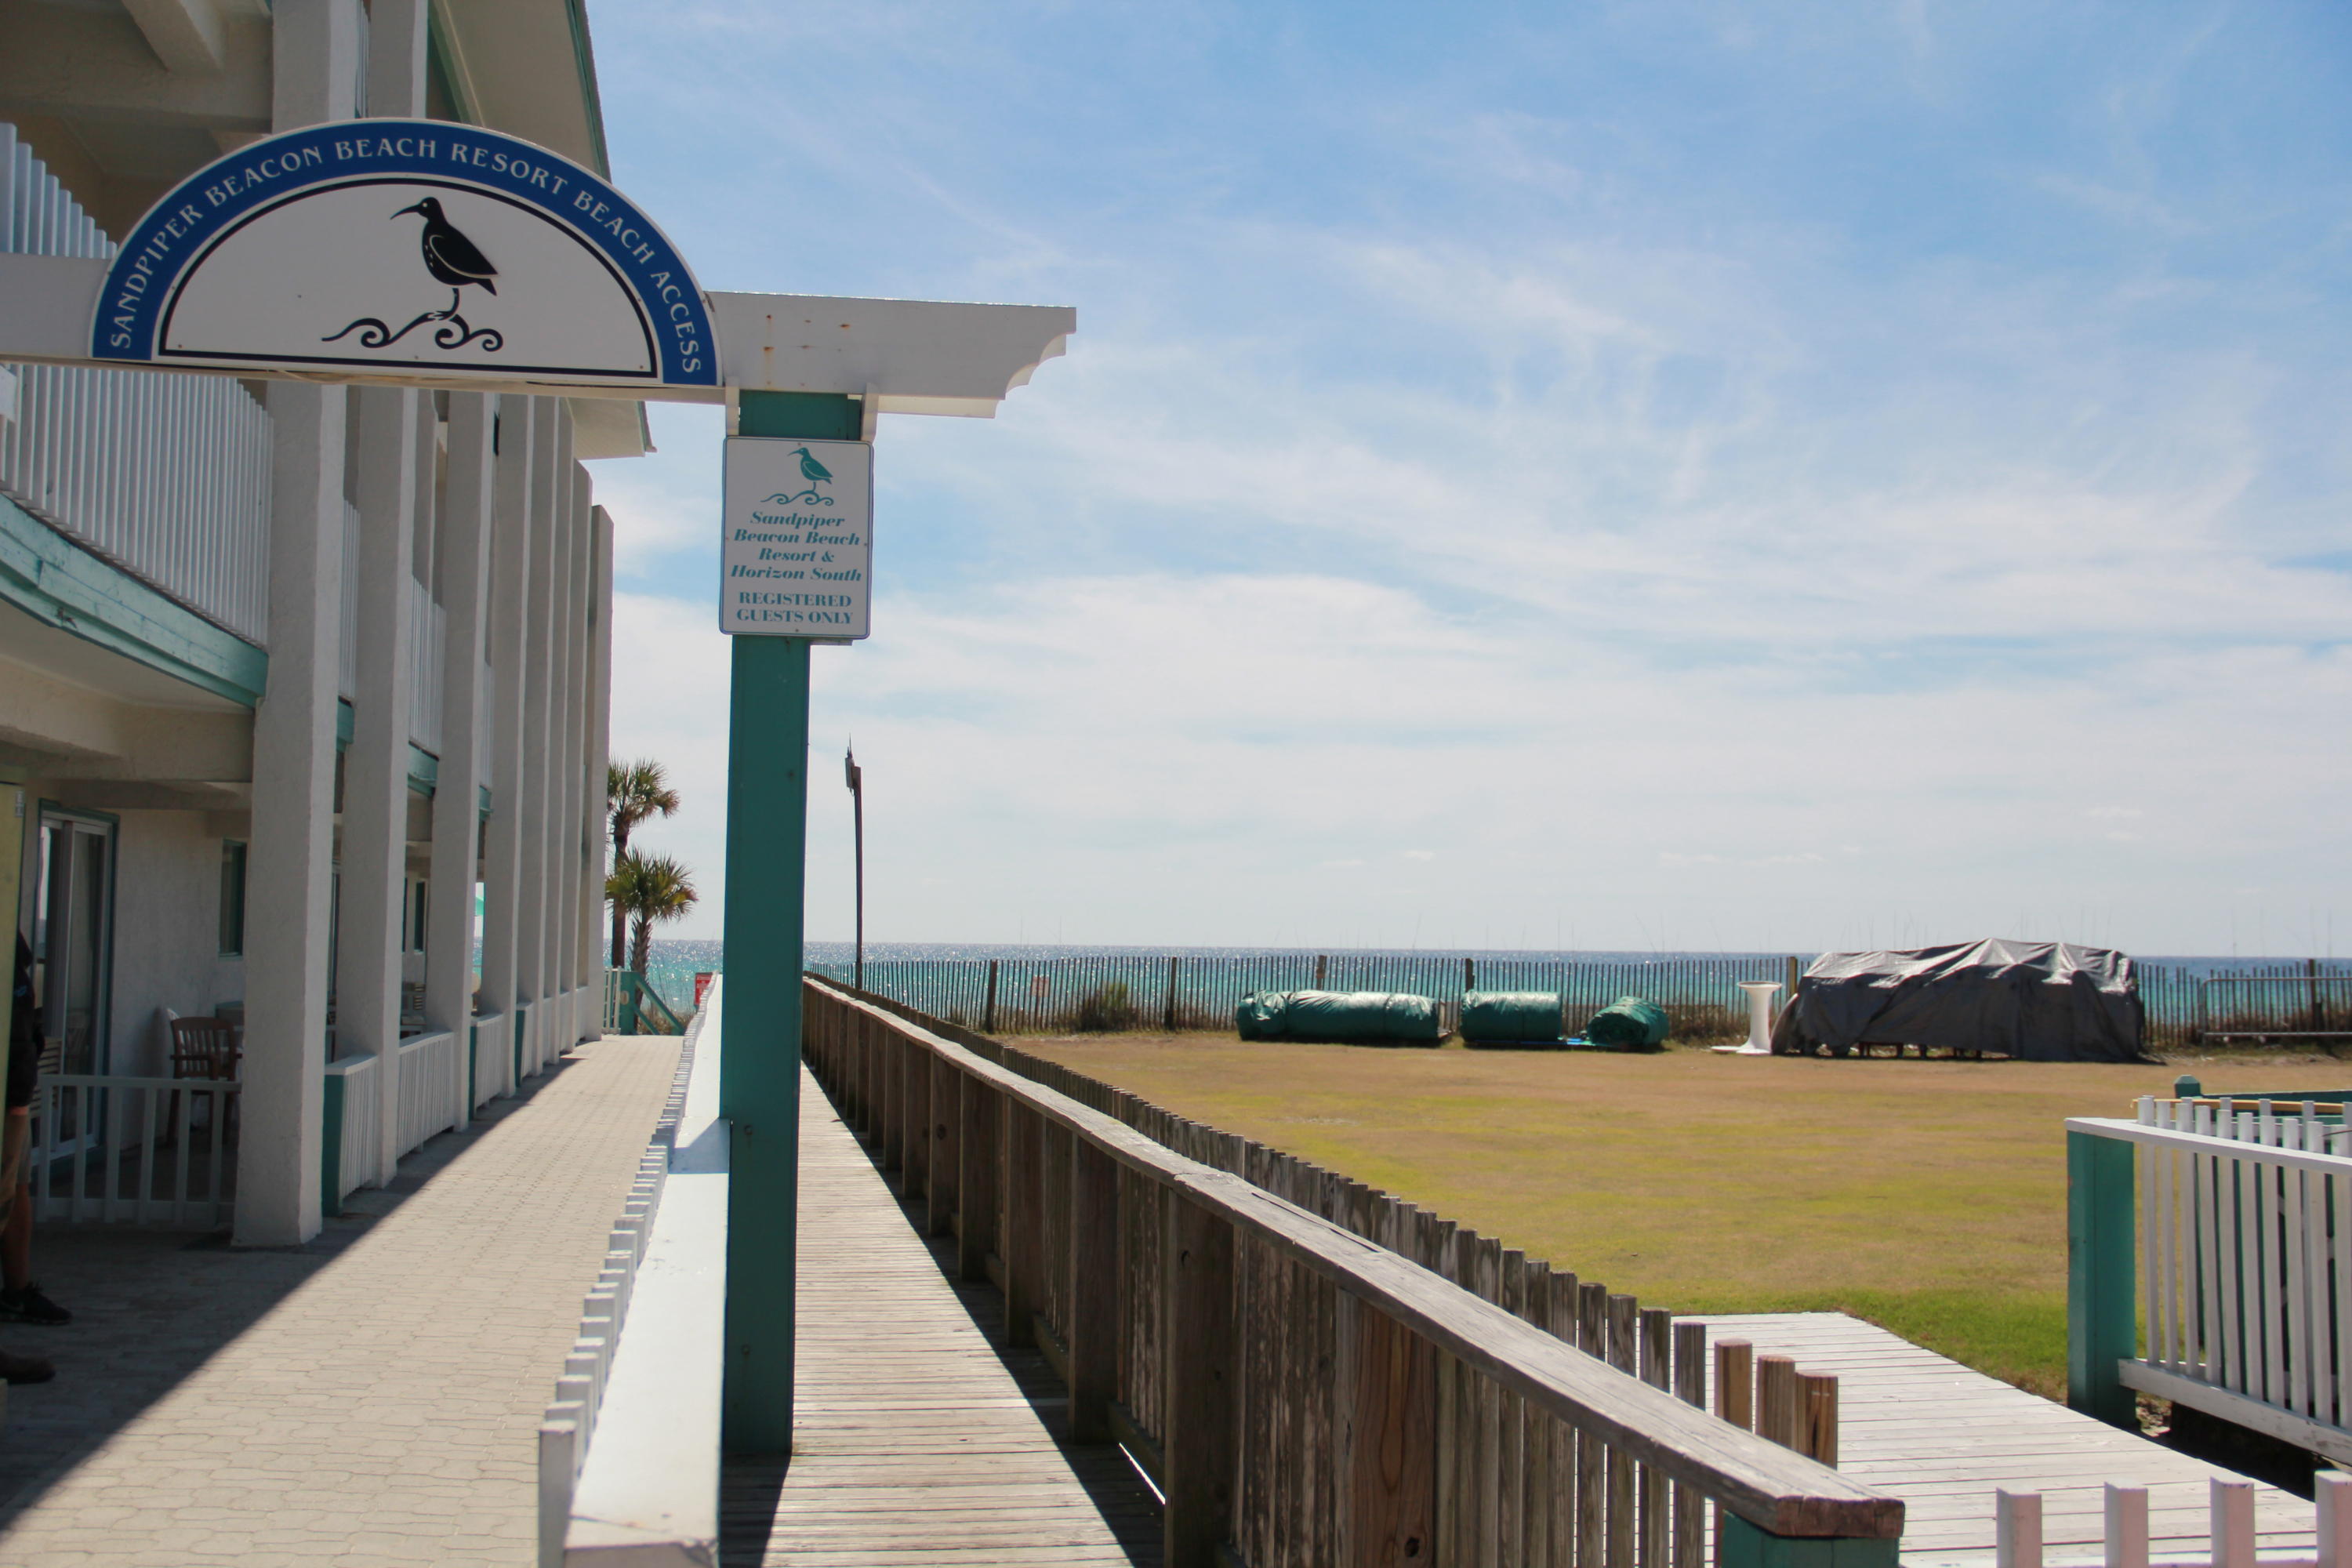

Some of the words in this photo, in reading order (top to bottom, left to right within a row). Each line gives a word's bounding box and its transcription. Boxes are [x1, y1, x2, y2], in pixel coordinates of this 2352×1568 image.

[111, 204, 203, 349] SANDPIPER
[205, 146, 322, 207] BEACON
[335, 138, 436, 160] BEACH
[452, 143, 568, 194] RESORT
[572, 191, 655, 264] BEACH
[651, 270, 701, 374] ACCESS
[750, 510, 845, 529] Sandpiper
[734, 528, 800, 543] Beacon
[805, 531, 860, 546] Beach
[758, 547, 815, 562] Resort
[821, 550, 834, 562] &
[731, 564, 804, 580] Horizon
[810, 567, 862, 582] South
[739, 591, 852, 608] REGISTERED
[736, 608, 804, 622] GUESTS
[808, 611, 854, 624] ONLY
